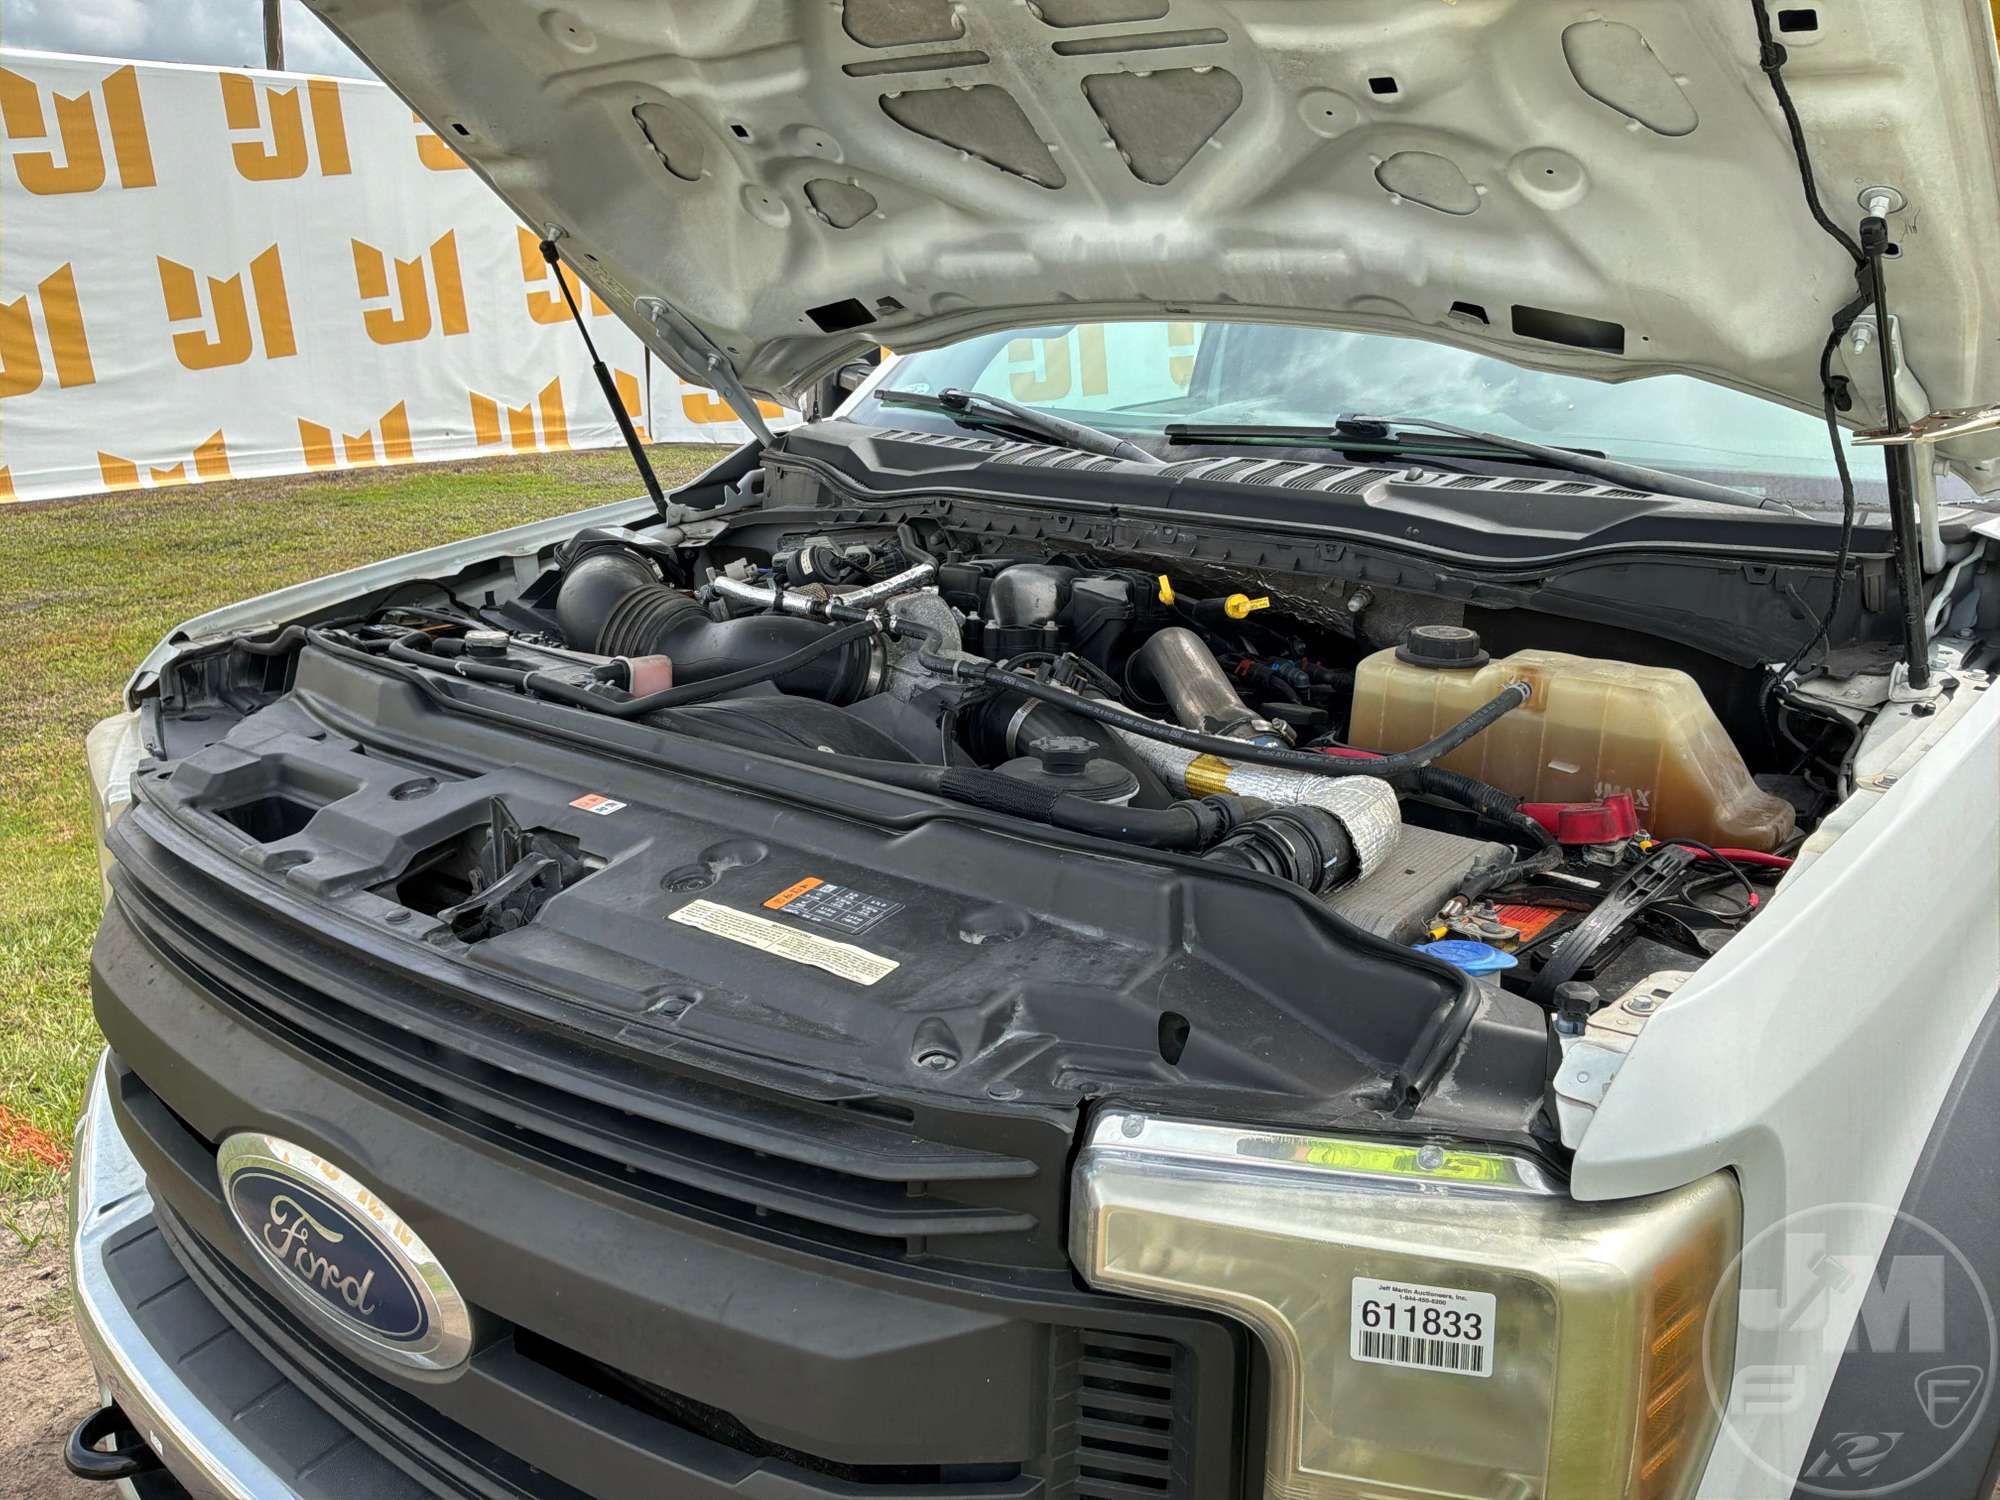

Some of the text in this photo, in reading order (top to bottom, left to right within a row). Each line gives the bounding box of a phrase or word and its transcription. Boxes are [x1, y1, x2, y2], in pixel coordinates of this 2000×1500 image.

[264, 1194, 376, 1315] Ford
[1392, 1286, 1413, 1295] Martin
[1361, 1299, 1483, 1341] 611833
